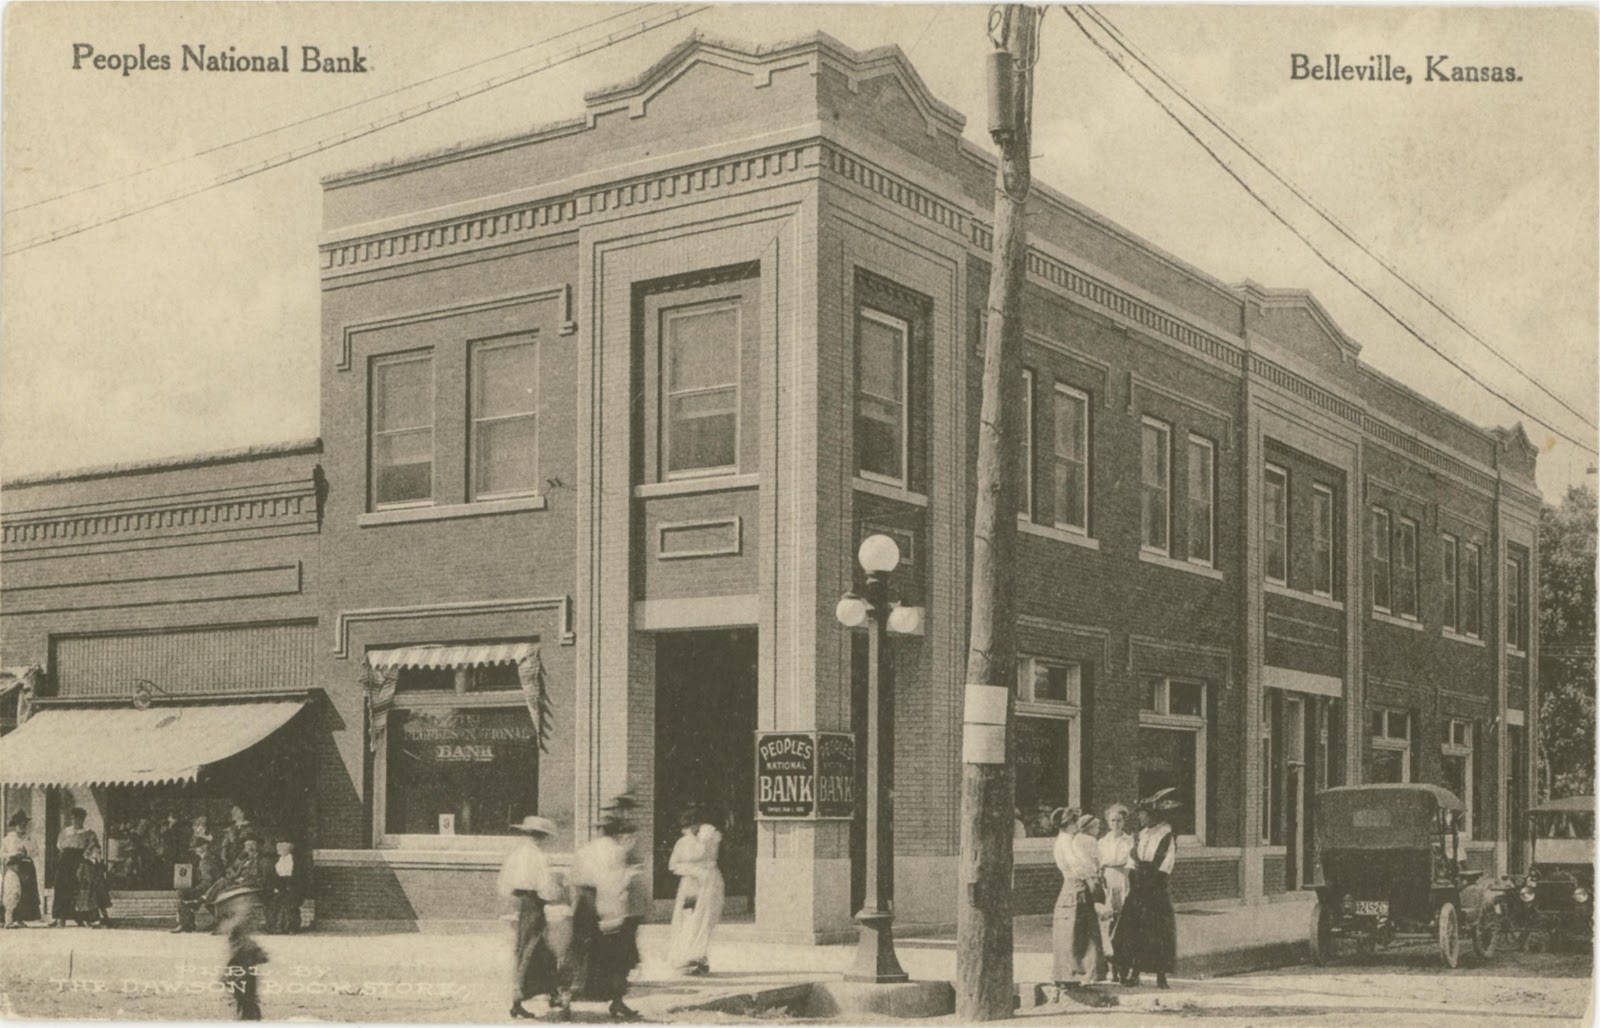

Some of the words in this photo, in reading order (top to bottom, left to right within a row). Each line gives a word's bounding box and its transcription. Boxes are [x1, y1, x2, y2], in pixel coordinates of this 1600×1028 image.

[463, 727, 531, 740] NTIONAL
[436, 745, 495, 760] BANK
[760, 738, 813, 760] PEOPLES
[766, 761, 807, 770] NATIONAL
[760, 775, 813, 802] BANK
[820, 775, 853, 802] BANK
